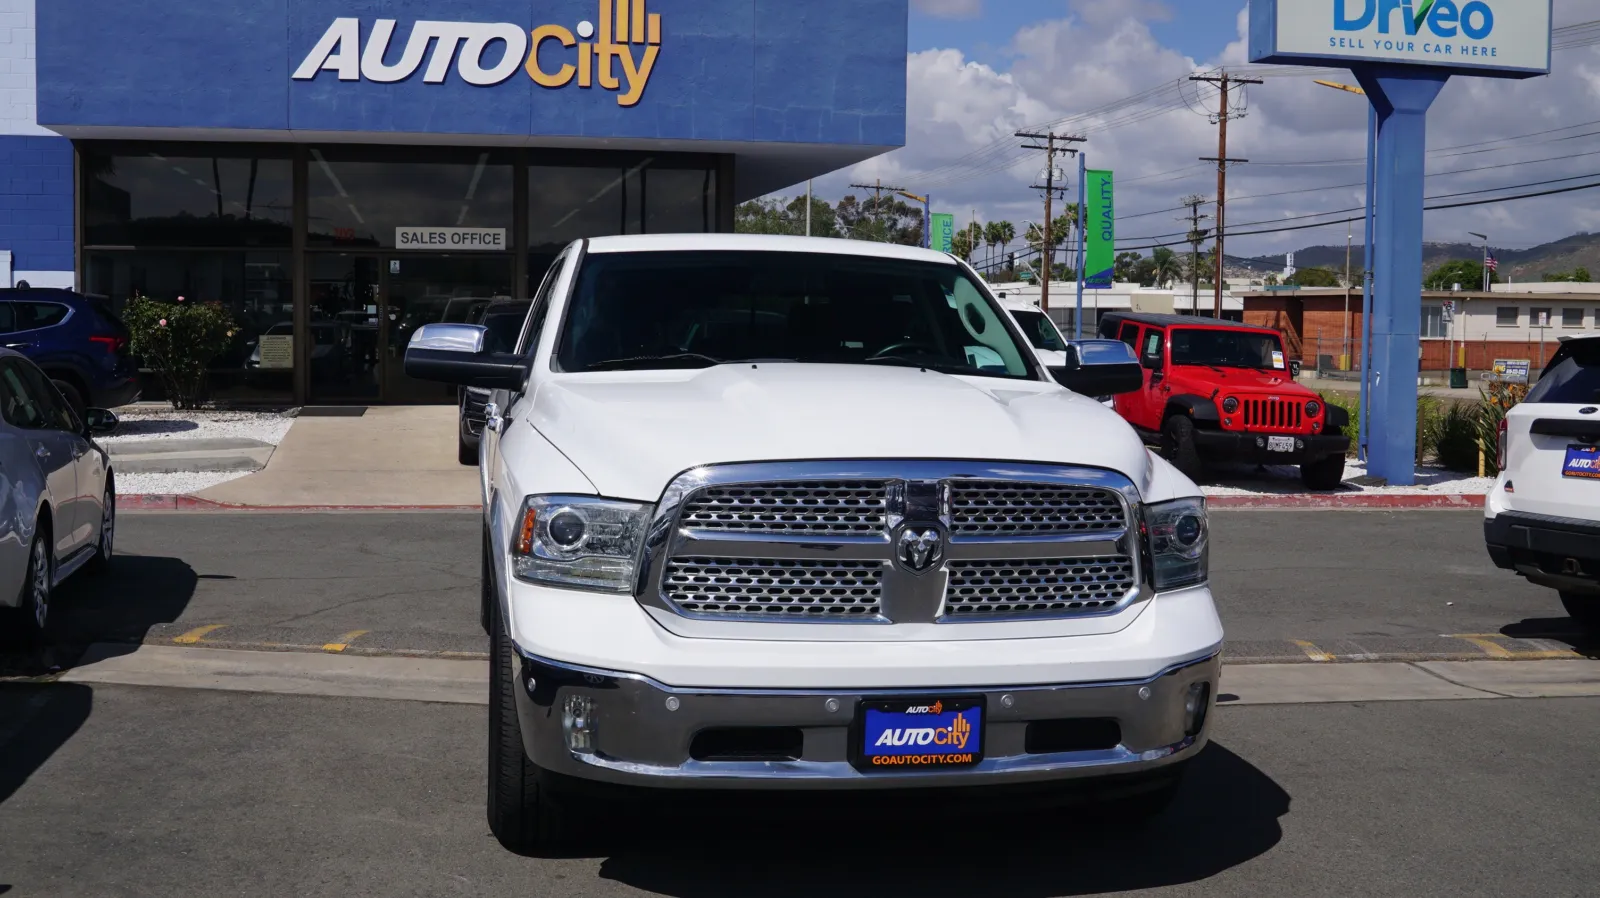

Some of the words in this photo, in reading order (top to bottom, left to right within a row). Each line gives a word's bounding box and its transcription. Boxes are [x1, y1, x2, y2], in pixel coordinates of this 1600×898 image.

[1329, 37, 1365, 49] SELL
[1373, 39, 1415, 52] YOUR
[1423, 43, 1453, 54] CAR
[1460, 46, 1497, 57] HERE
[400, 232, 447, 245] SALES
[450, 232, 502, 245] OFFICE
[872, 753, 972, 765] GOAUTOCITY.COM
